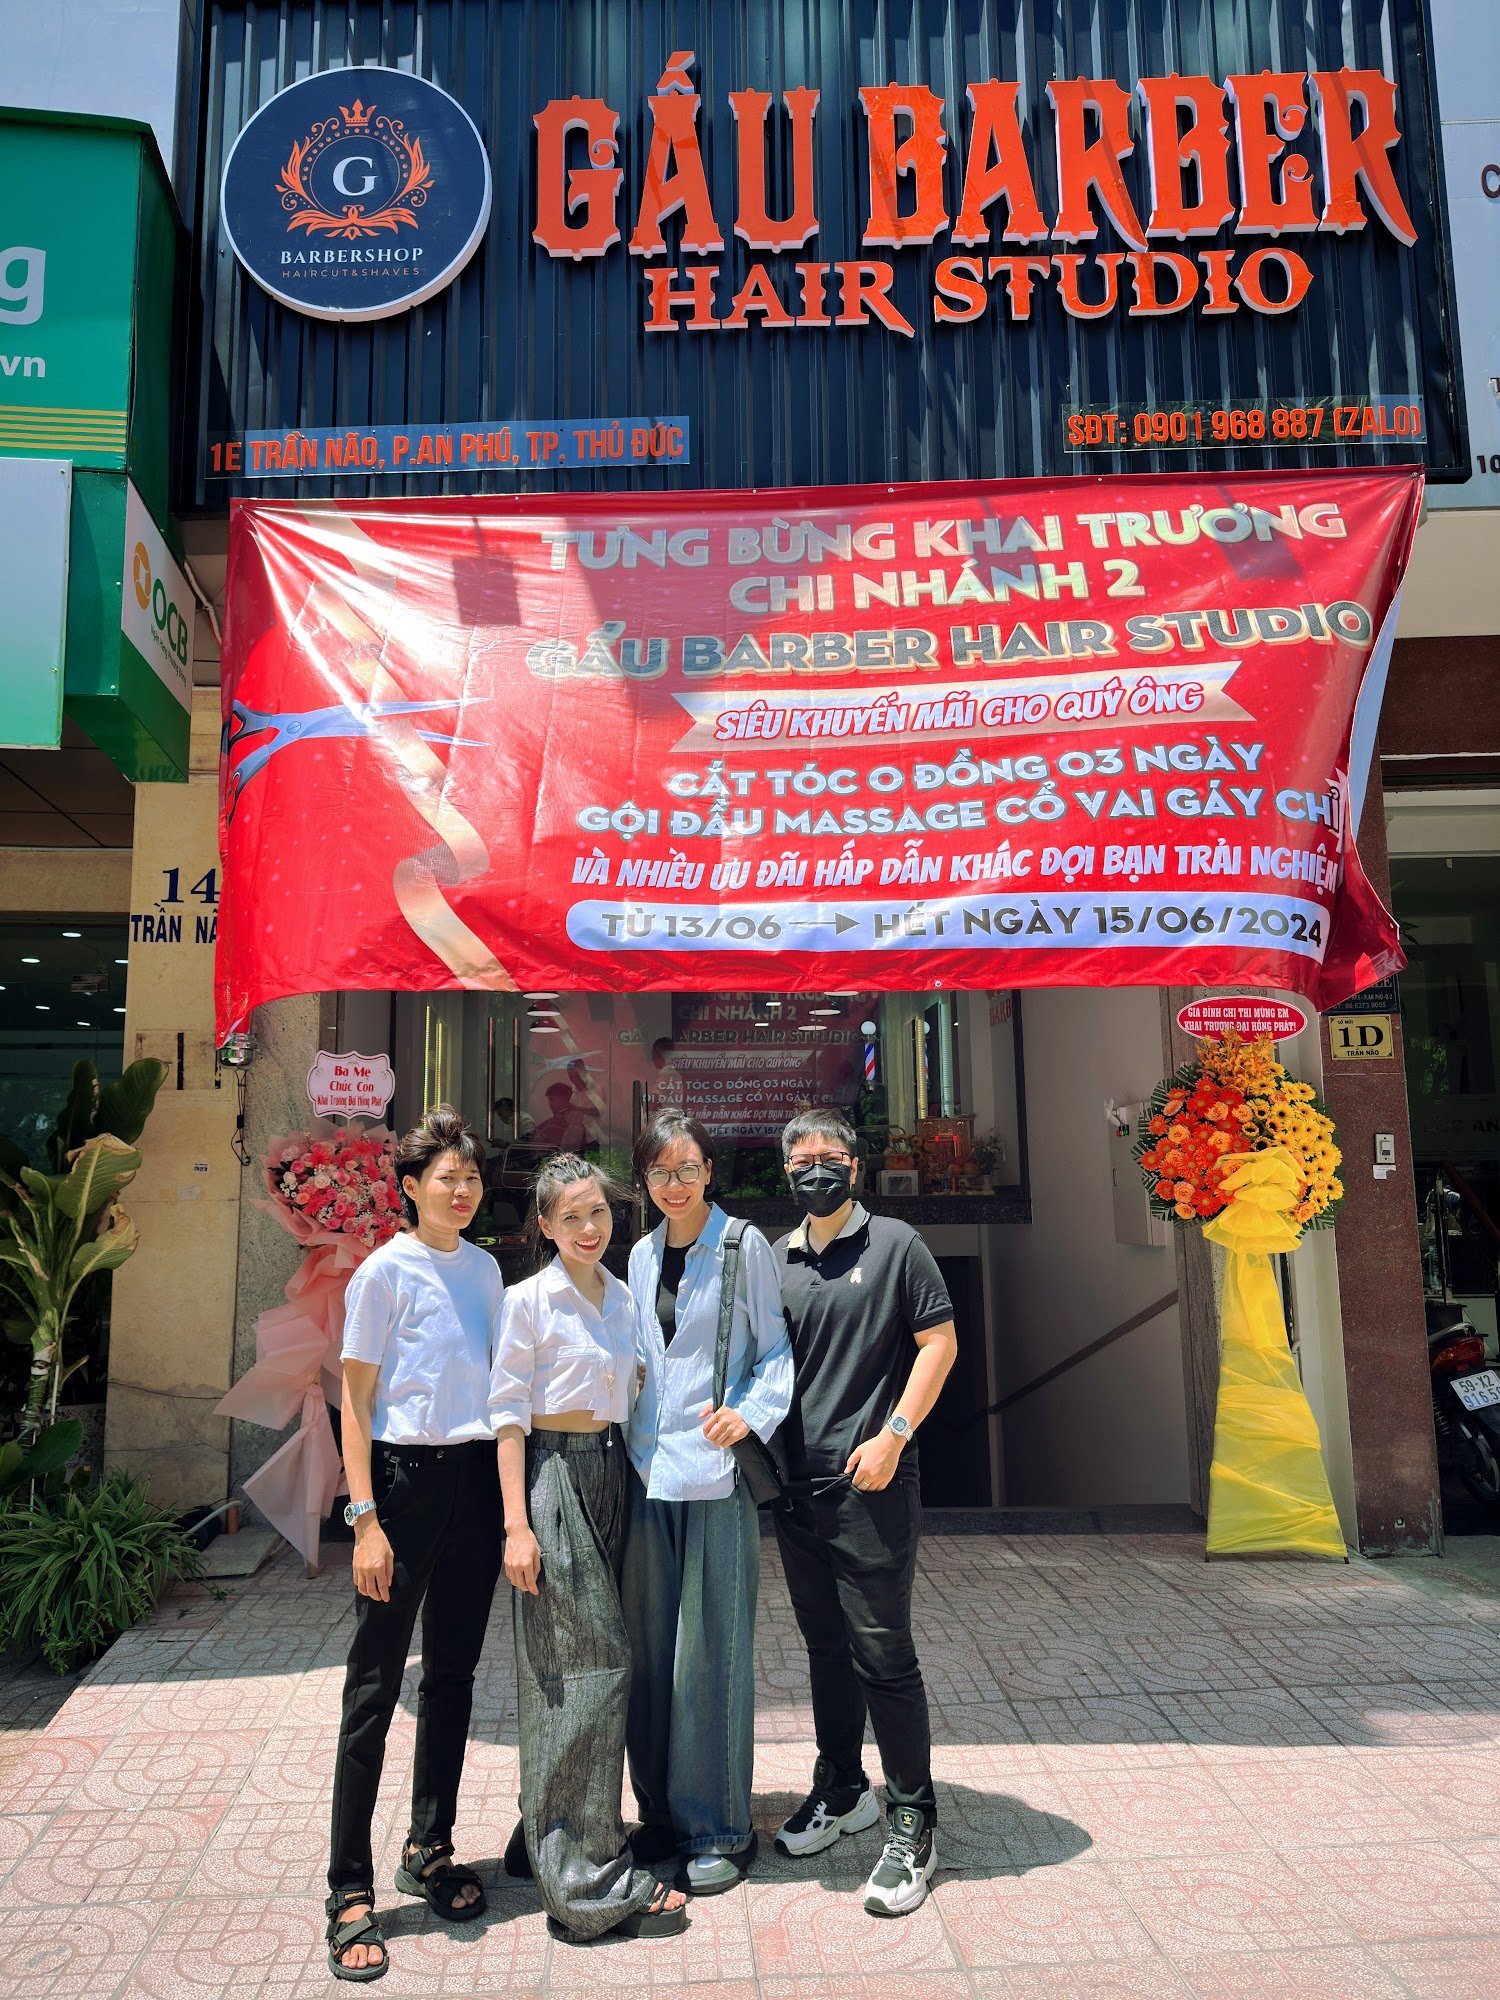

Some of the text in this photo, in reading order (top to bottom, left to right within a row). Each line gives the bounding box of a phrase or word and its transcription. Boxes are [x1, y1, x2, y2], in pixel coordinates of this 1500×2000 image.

[333, 156, 378, 196] G
[532, 51, 1418, 261] GẤU BARBER
[281, 248, 423, 264] BARBERSHOP
[282, 267, 420, 278] HAIRCUT&SHAVES
[643, 247, 1314, 338] HAIR STUDIO
[210, 442, 241, 472] 1E
[249, 431, 317, 471] TRẦN
[325, 432, 385, 470] NÃO,
[461, 427, 519, 466] PHÚ,
[526, 431, 566, 463] TP.
[573, 420, 624, 459] THỦ
[630, 421, 684, 457] ĐỨC
[1068, 405, 1421, 445] SĐT: 0901 968 887 (ZALO)
[541, 503, 1348, 570] TƯNG BỪNG KHAI TRƯƠNG
[729, 558, 1146, 613] CHI NHÁNH 2
[153, 579, 187, 666] OCB
[526, 600, 1374, 680] GẤU BARBER HAIR STUDIO
[714, 675, 1204, 740] SIÊU KHUYẾN MÃI CHO QUÝ ÔNG
[667, 759, 757, 797] CẮT
[765, 762, 860, 797] TÓC
[913, 747, 1049, 790] ĐỒNG
[1132, 734, 1265, 773] NGÀY
[576, 799, 661, 840] GỘI
[669, 797, 764, 837] ĐẦU
[774, 799, 988, 837] MASSAGE
[994, 780, 1067, 825] CỔ
[1073, 786, 1157, 819] VAI
[1165, 778, 1265, 818] GÁY
[571, 837, 1338, 896] VÀ NHIỀU ƯU ĐÃI HẤP DẪN KHÁC ĐỢI BẠN TRẢI NGHIỆM
[131, 902, 182, 943] TRẦN
[602, 900, 1322, 948] TỪ 13/06 HẾT NGÀY 15/06/2024
[1338, 1025, 1384, 1047] 1D
[1459, 1374, 1495, 1393] 59-X2
